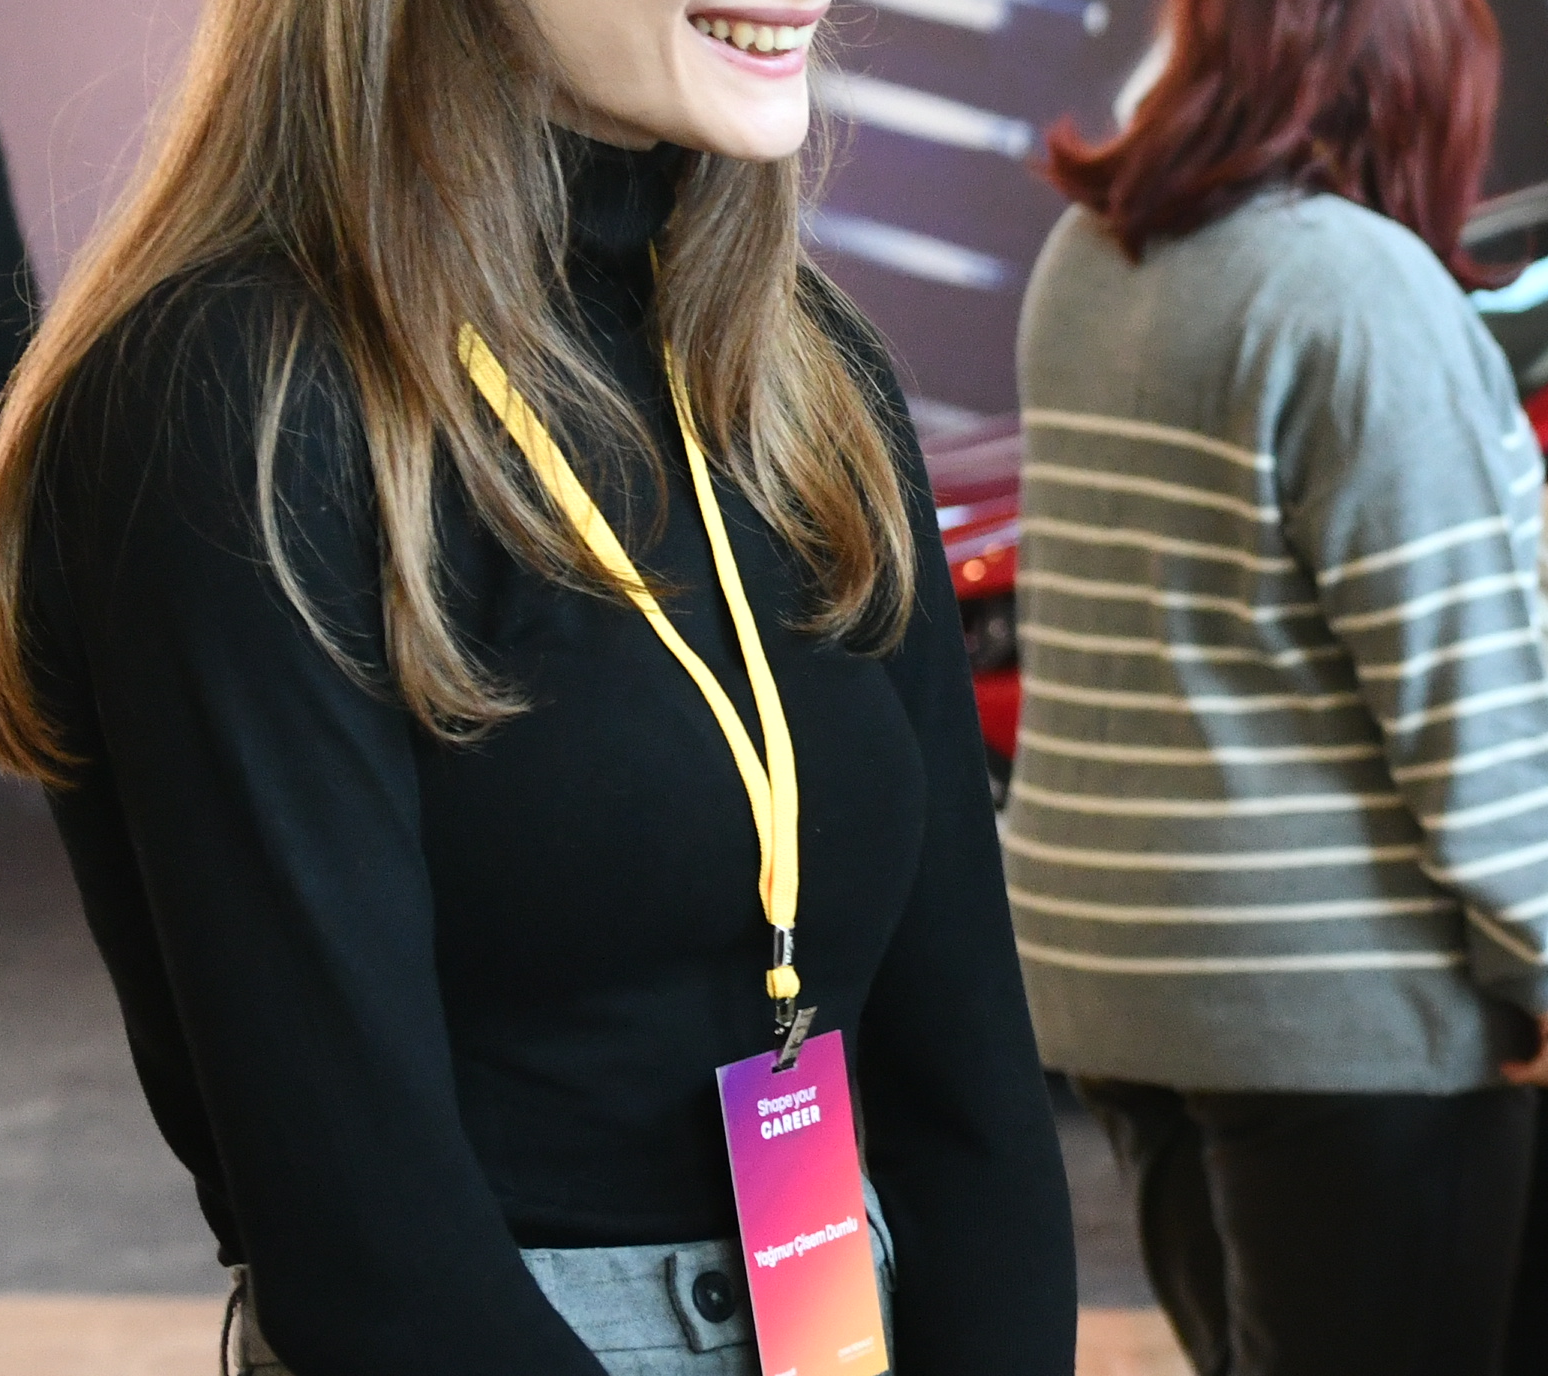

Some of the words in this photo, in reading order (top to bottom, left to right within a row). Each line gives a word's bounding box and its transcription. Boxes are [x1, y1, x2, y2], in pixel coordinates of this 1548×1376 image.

[757, 1095, 794, 1118] Shape
[793, 1085, 818, 1110] your
[760, 1106, 820, 1139] CAREER
